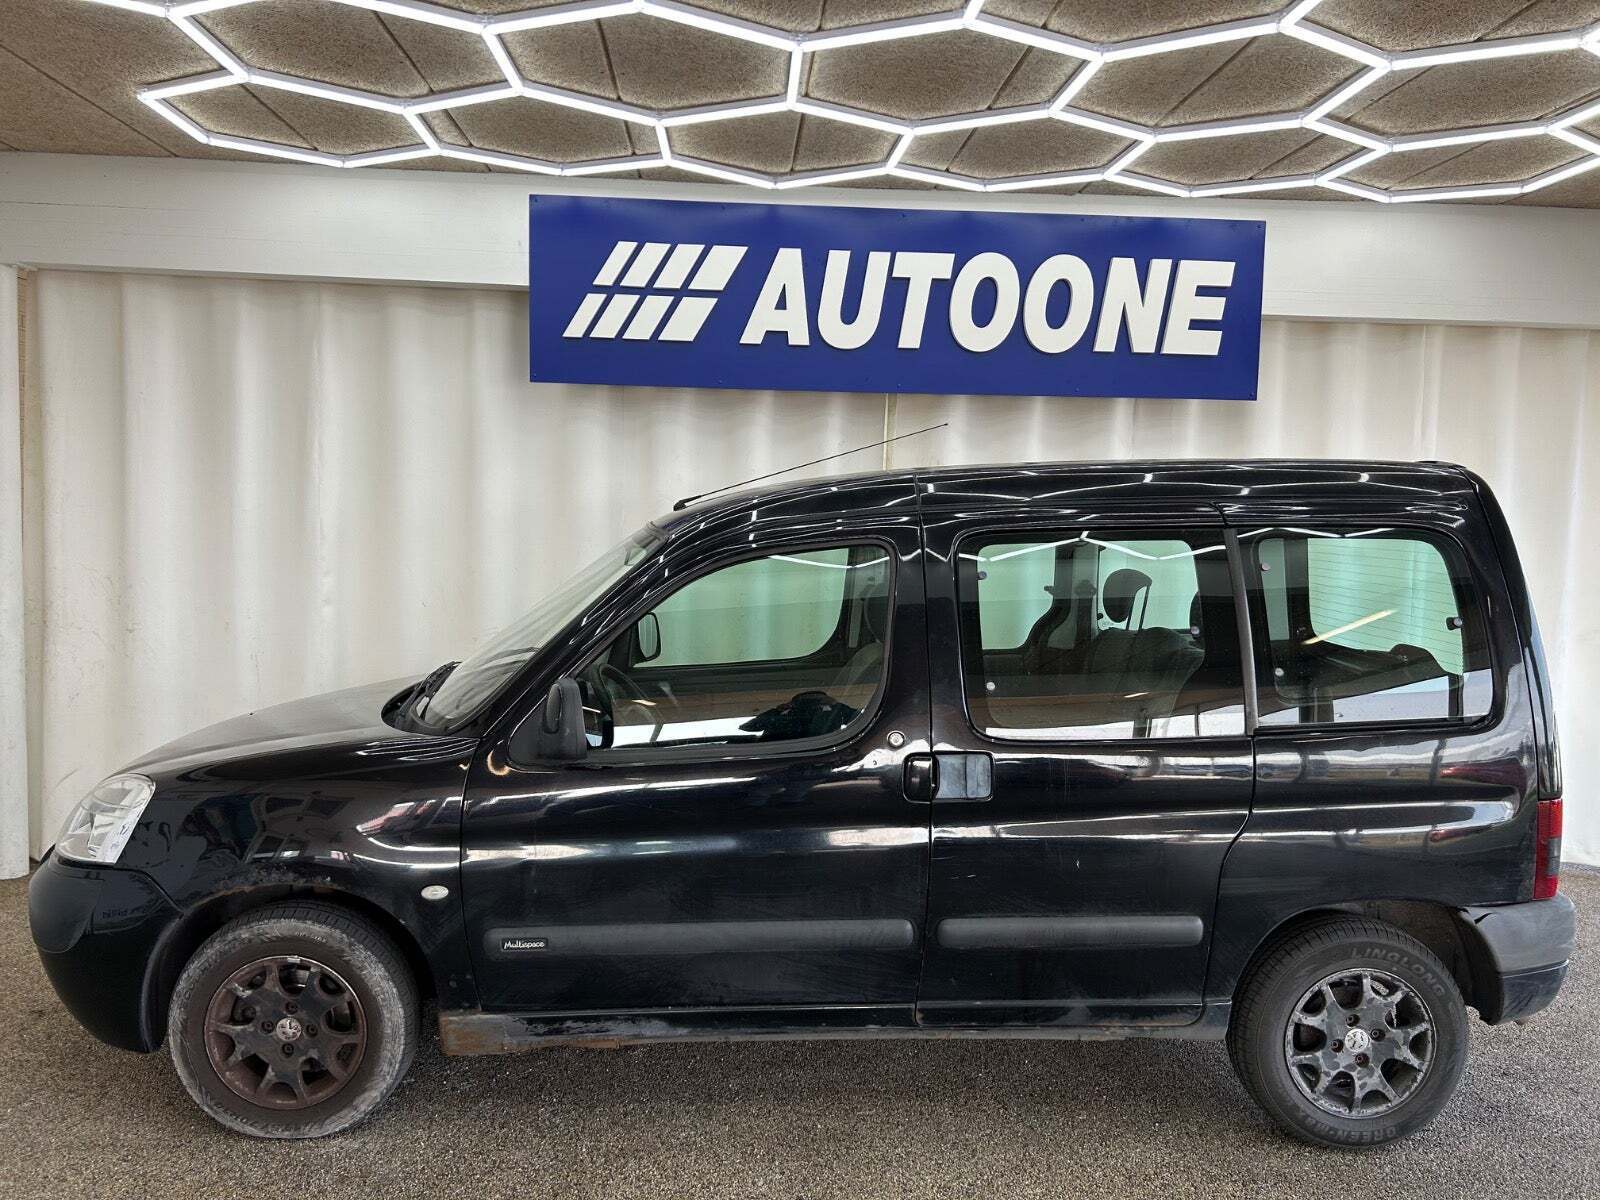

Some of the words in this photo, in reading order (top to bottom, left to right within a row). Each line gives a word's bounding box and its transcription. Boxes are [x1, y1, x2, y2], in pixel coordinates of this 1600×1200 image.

[740, 247, 1236, 355] AUTOONE
[503, 940, 546, 950] Multispace
[1351, 947, 1446, 996] LINGLONG
